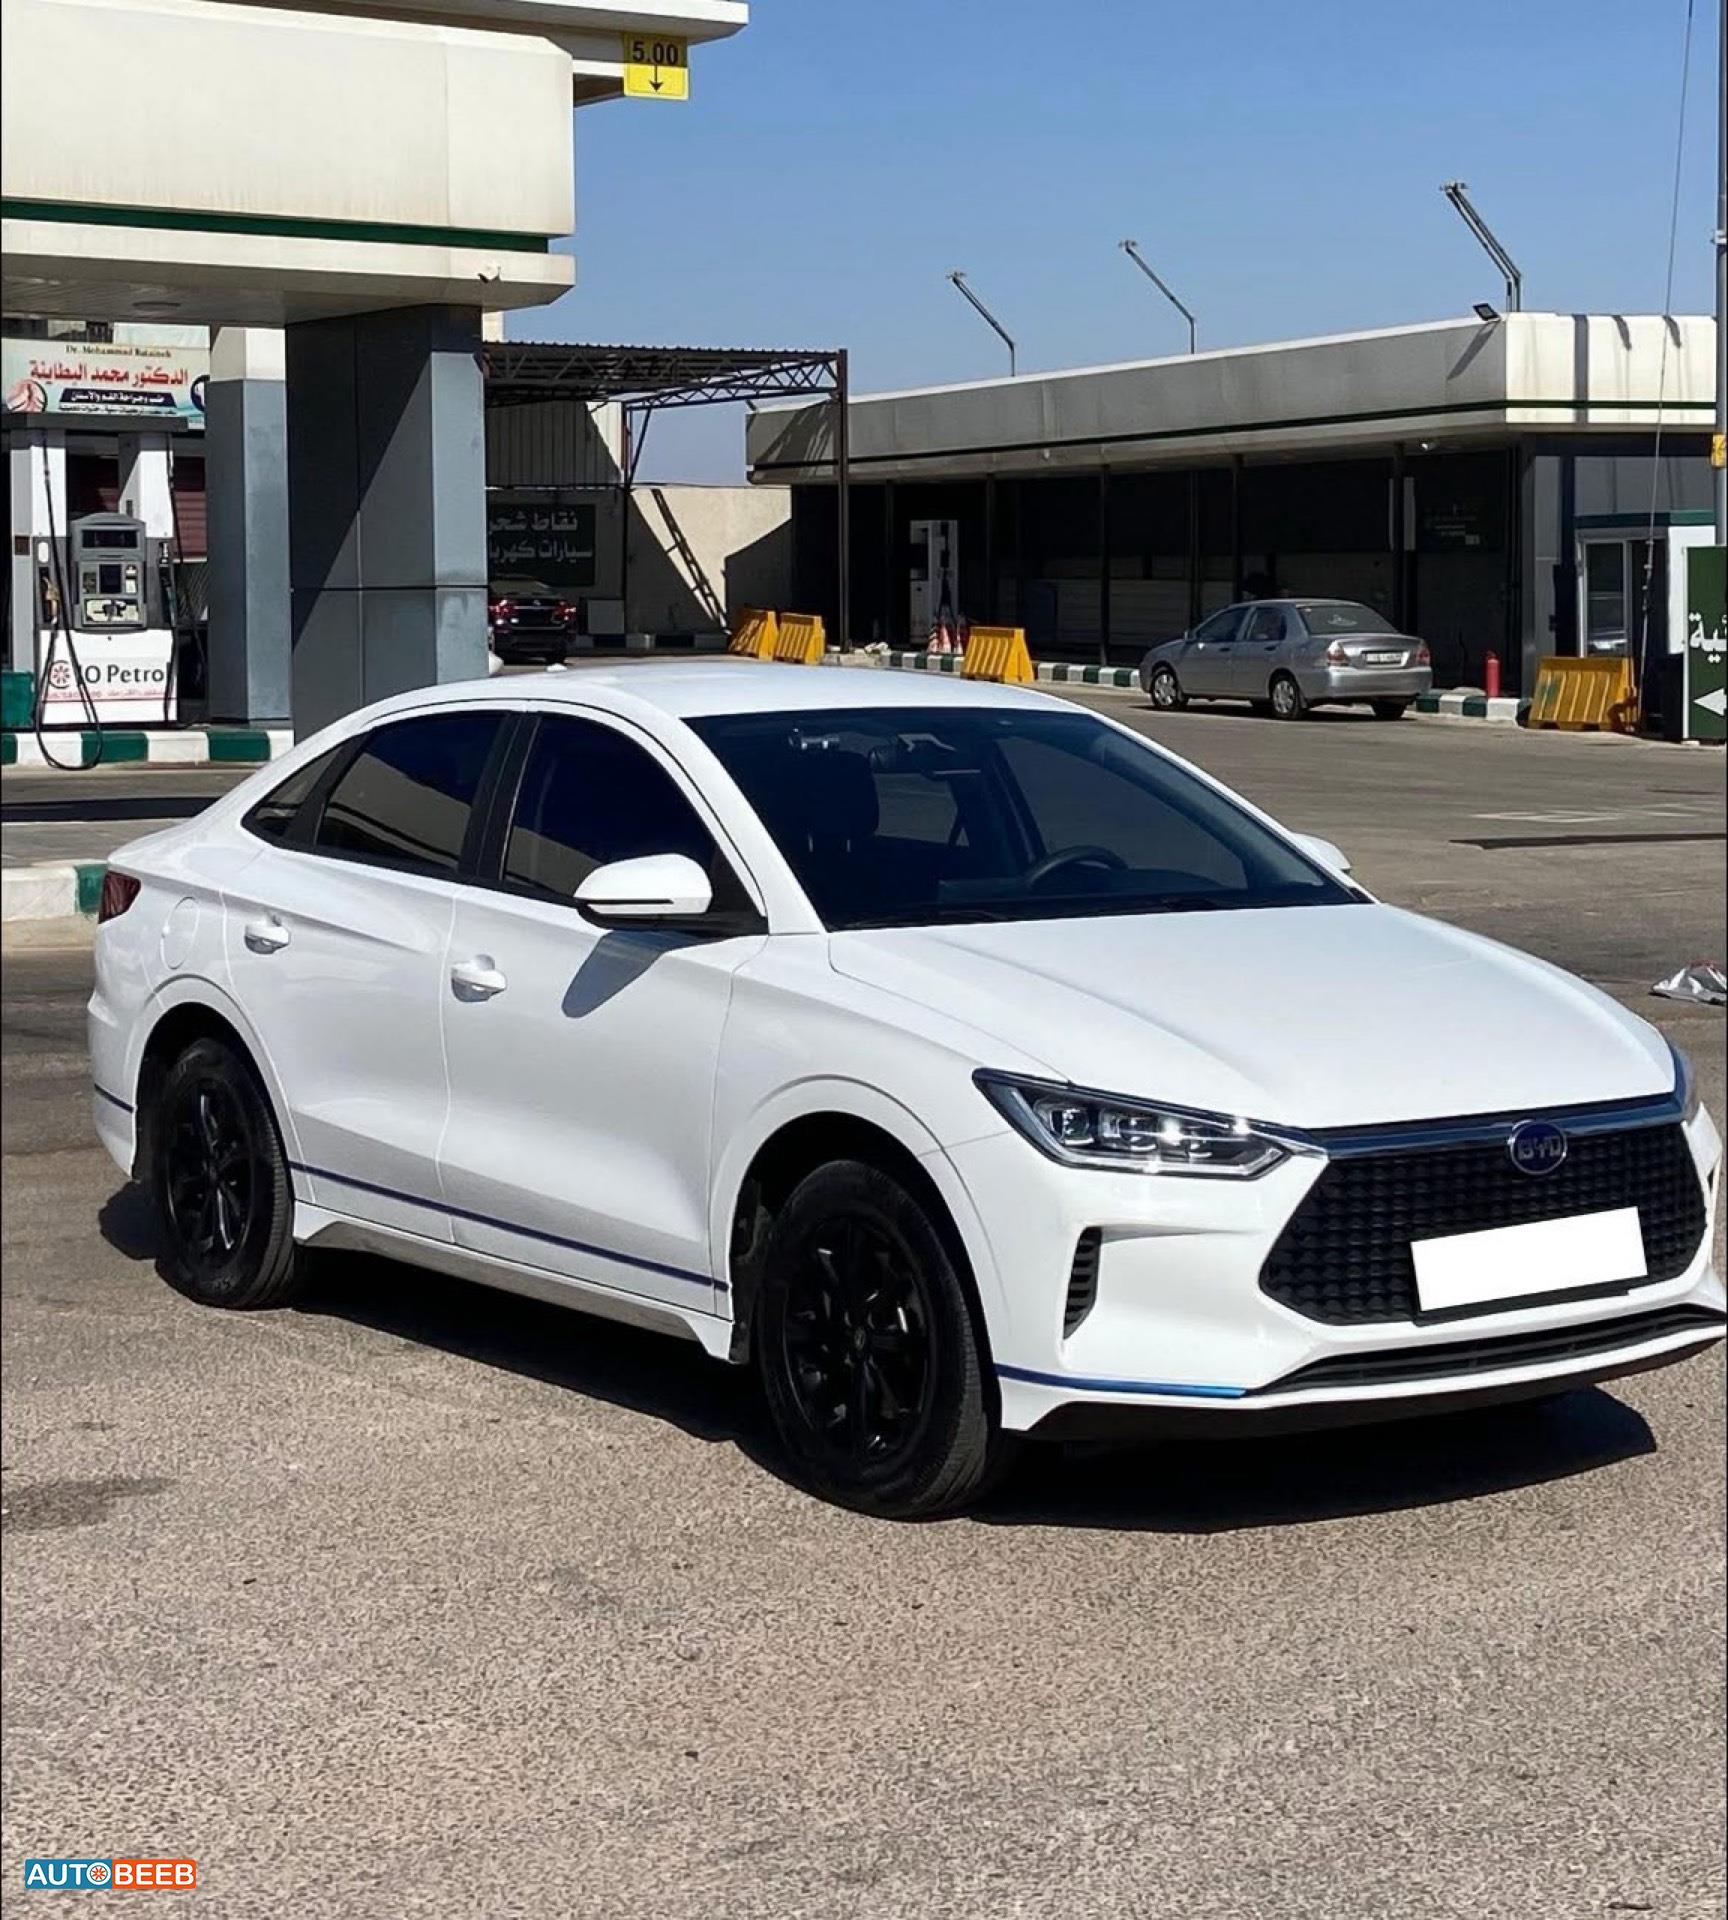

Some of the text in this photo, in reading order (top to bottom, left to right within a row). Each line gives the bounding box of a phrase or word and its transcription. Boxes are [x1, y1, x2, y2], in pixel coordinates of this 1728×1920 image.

[632, 41, 679, 65] 5.00
[29, 360, 188, 388] الدكتور محمد البطاينة
[531, 510, 578, 532] نقاط
[489, 540, 593, 563] سيارات كهربا
[1518, 1136, 1561, 1160] BYD
